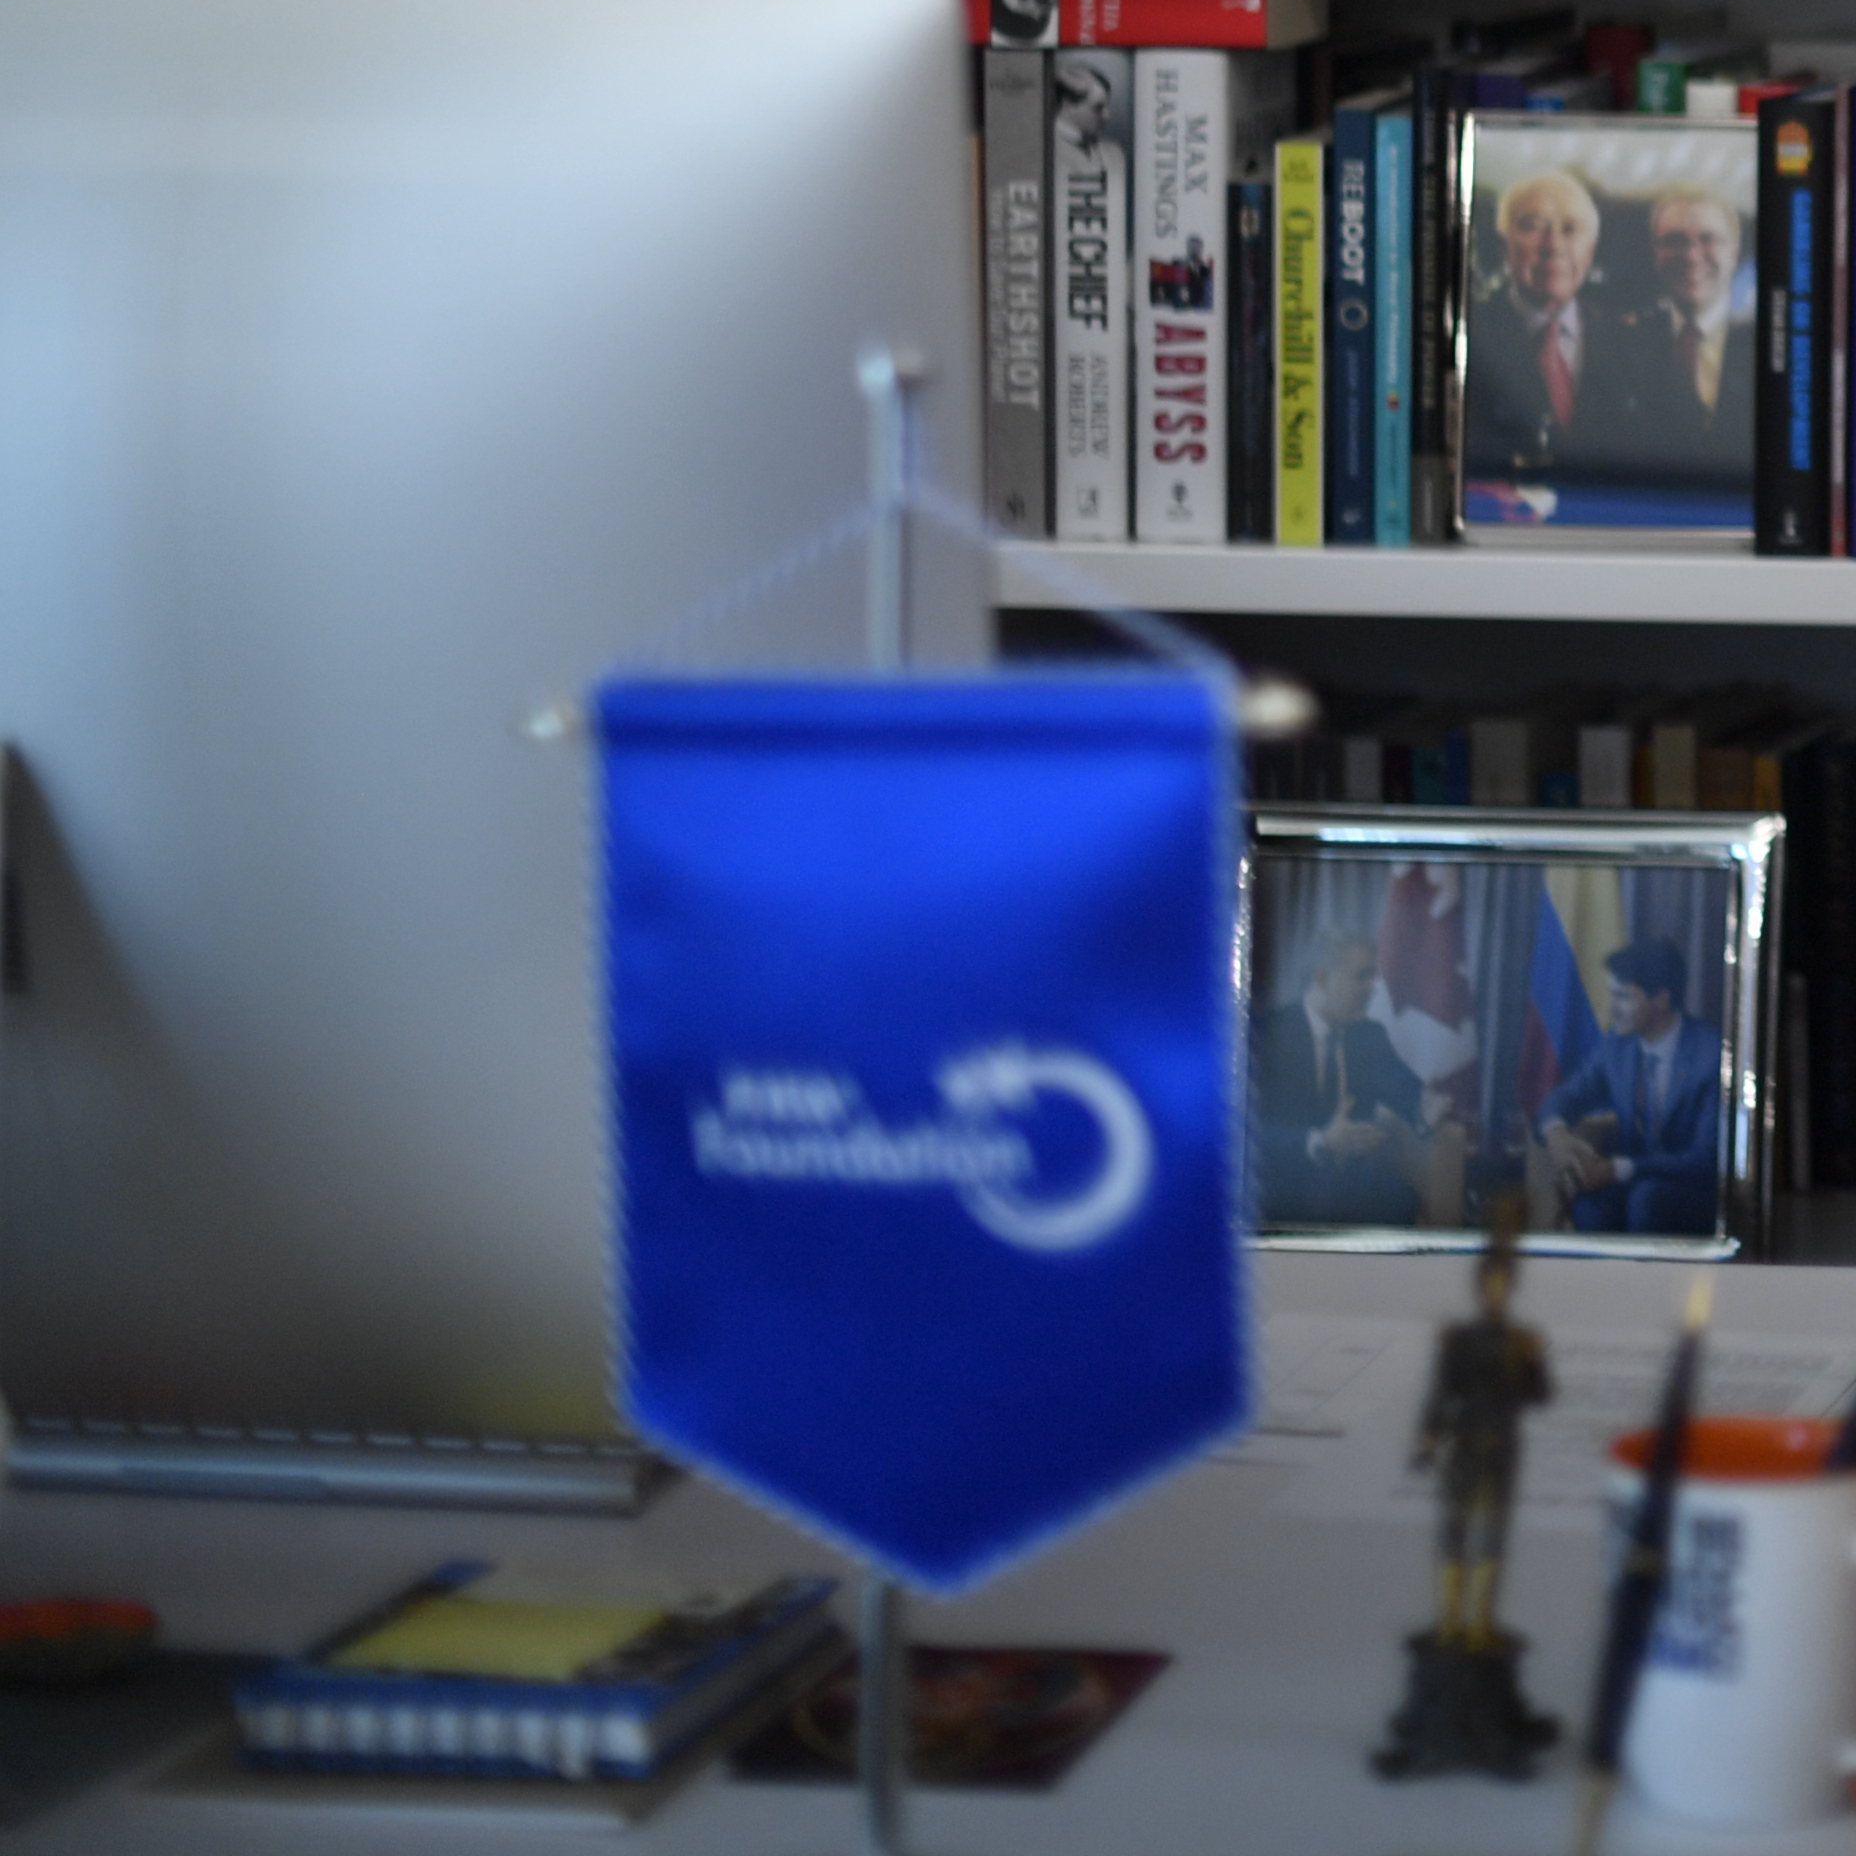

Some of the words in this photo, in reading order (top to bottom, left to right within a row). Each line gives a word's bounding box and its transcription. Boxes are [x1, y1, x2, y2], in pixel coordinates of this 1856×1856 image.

[1067, 169, 1109, 235] THE
[1154, 68, 1179, 240] HASTINGS
[1185, 113, 1209, 194] MAX
[1342, 157, 1365, 286] REBOOT
[1008, 178, 1040, 411] EARTHSHOT
[1067, 238, 1109, 333] CHIEF
[1282, 207, 1314, 364] Churchill
[1068, 352, 1087, 458] ROBERTS
[1153, 321, 1207, 465] ABYSS
[1282, 374, 1313, 400] &
[1282, 408, 1313, 471] Son
